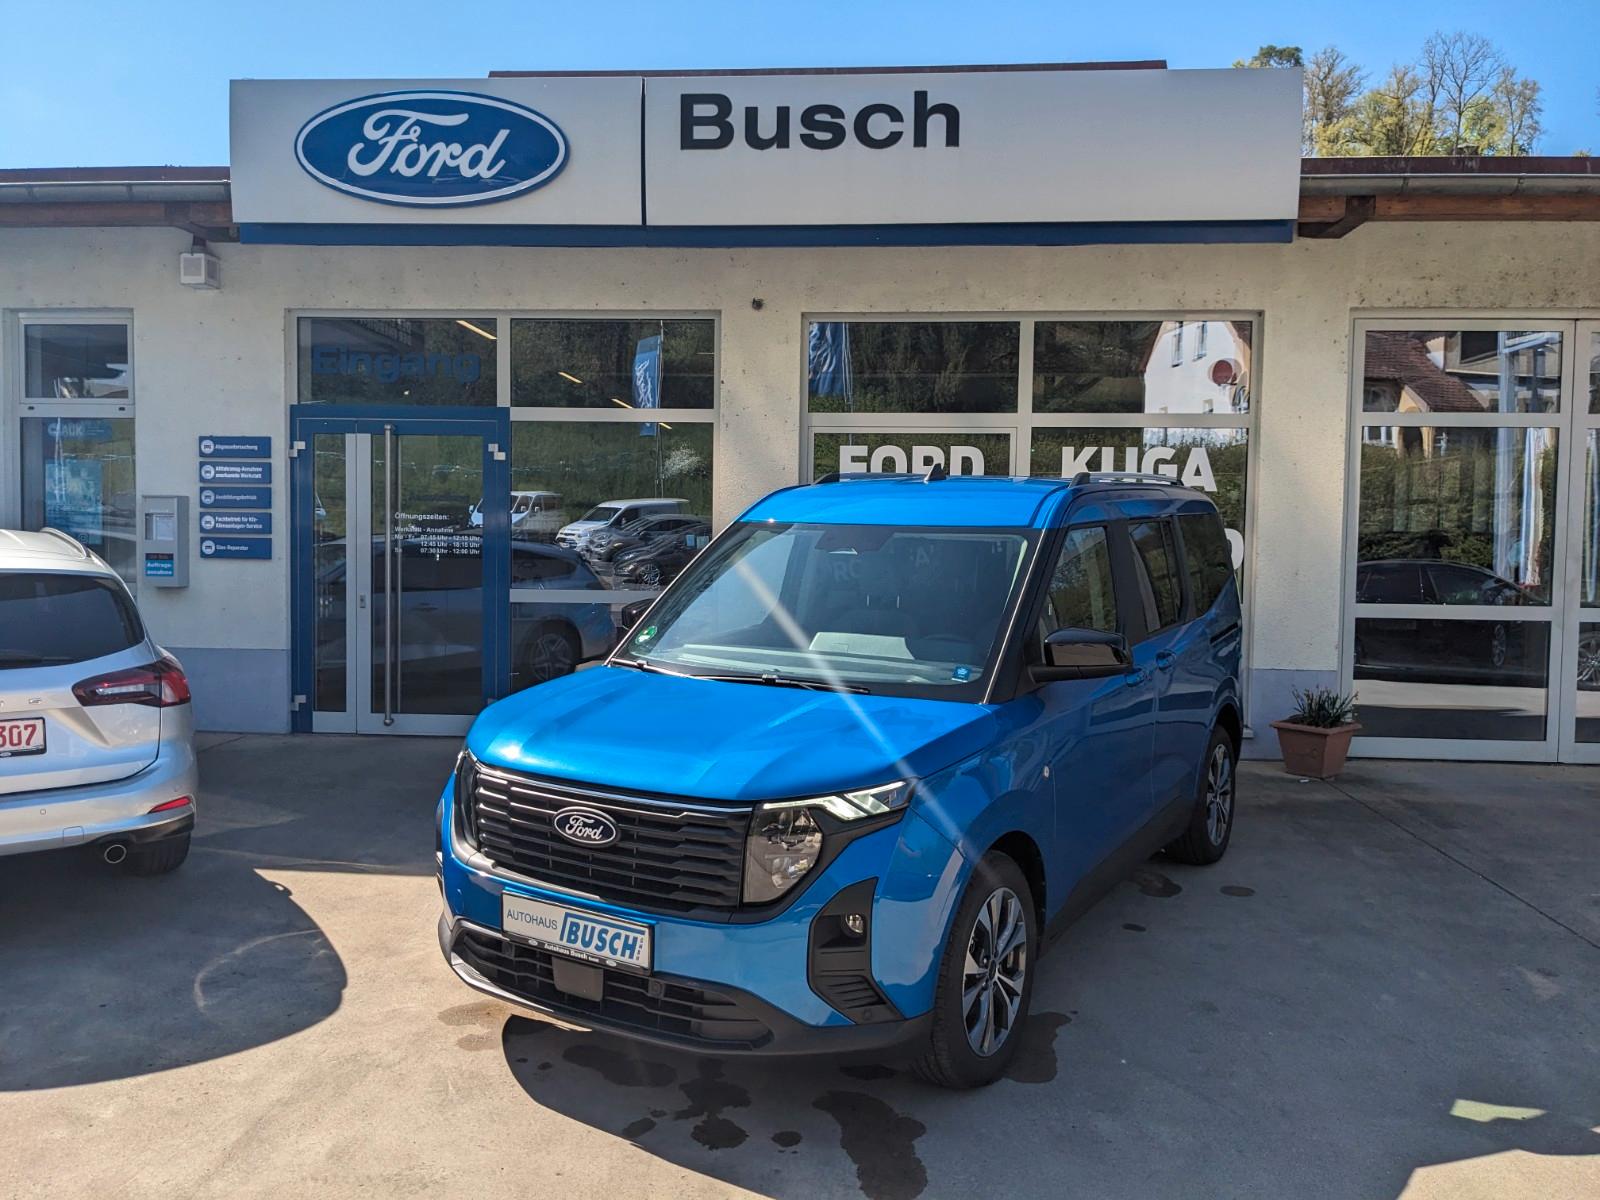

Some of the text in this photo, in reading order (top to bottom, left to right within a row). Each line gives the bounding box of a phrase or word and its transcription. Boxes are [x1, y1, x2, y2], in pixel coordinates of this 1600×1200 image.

[680, 90, 961, 152] Busch
[347, 108, 510, 180] Ford
[312, 345, 481, 384] Eingang
[839, 445, 1218, 492] FORD KUGA
[394, 511, 449, 520] Öffnungszeiten:
[565, 815, 604, 840] Ford
[506, 909, 558, 930] AUTOHAUS
[544, 943, 570, 956] Autohaus
[570, 949, 588, 960] Busch
[566, 920, 639, 960] BUSCH
